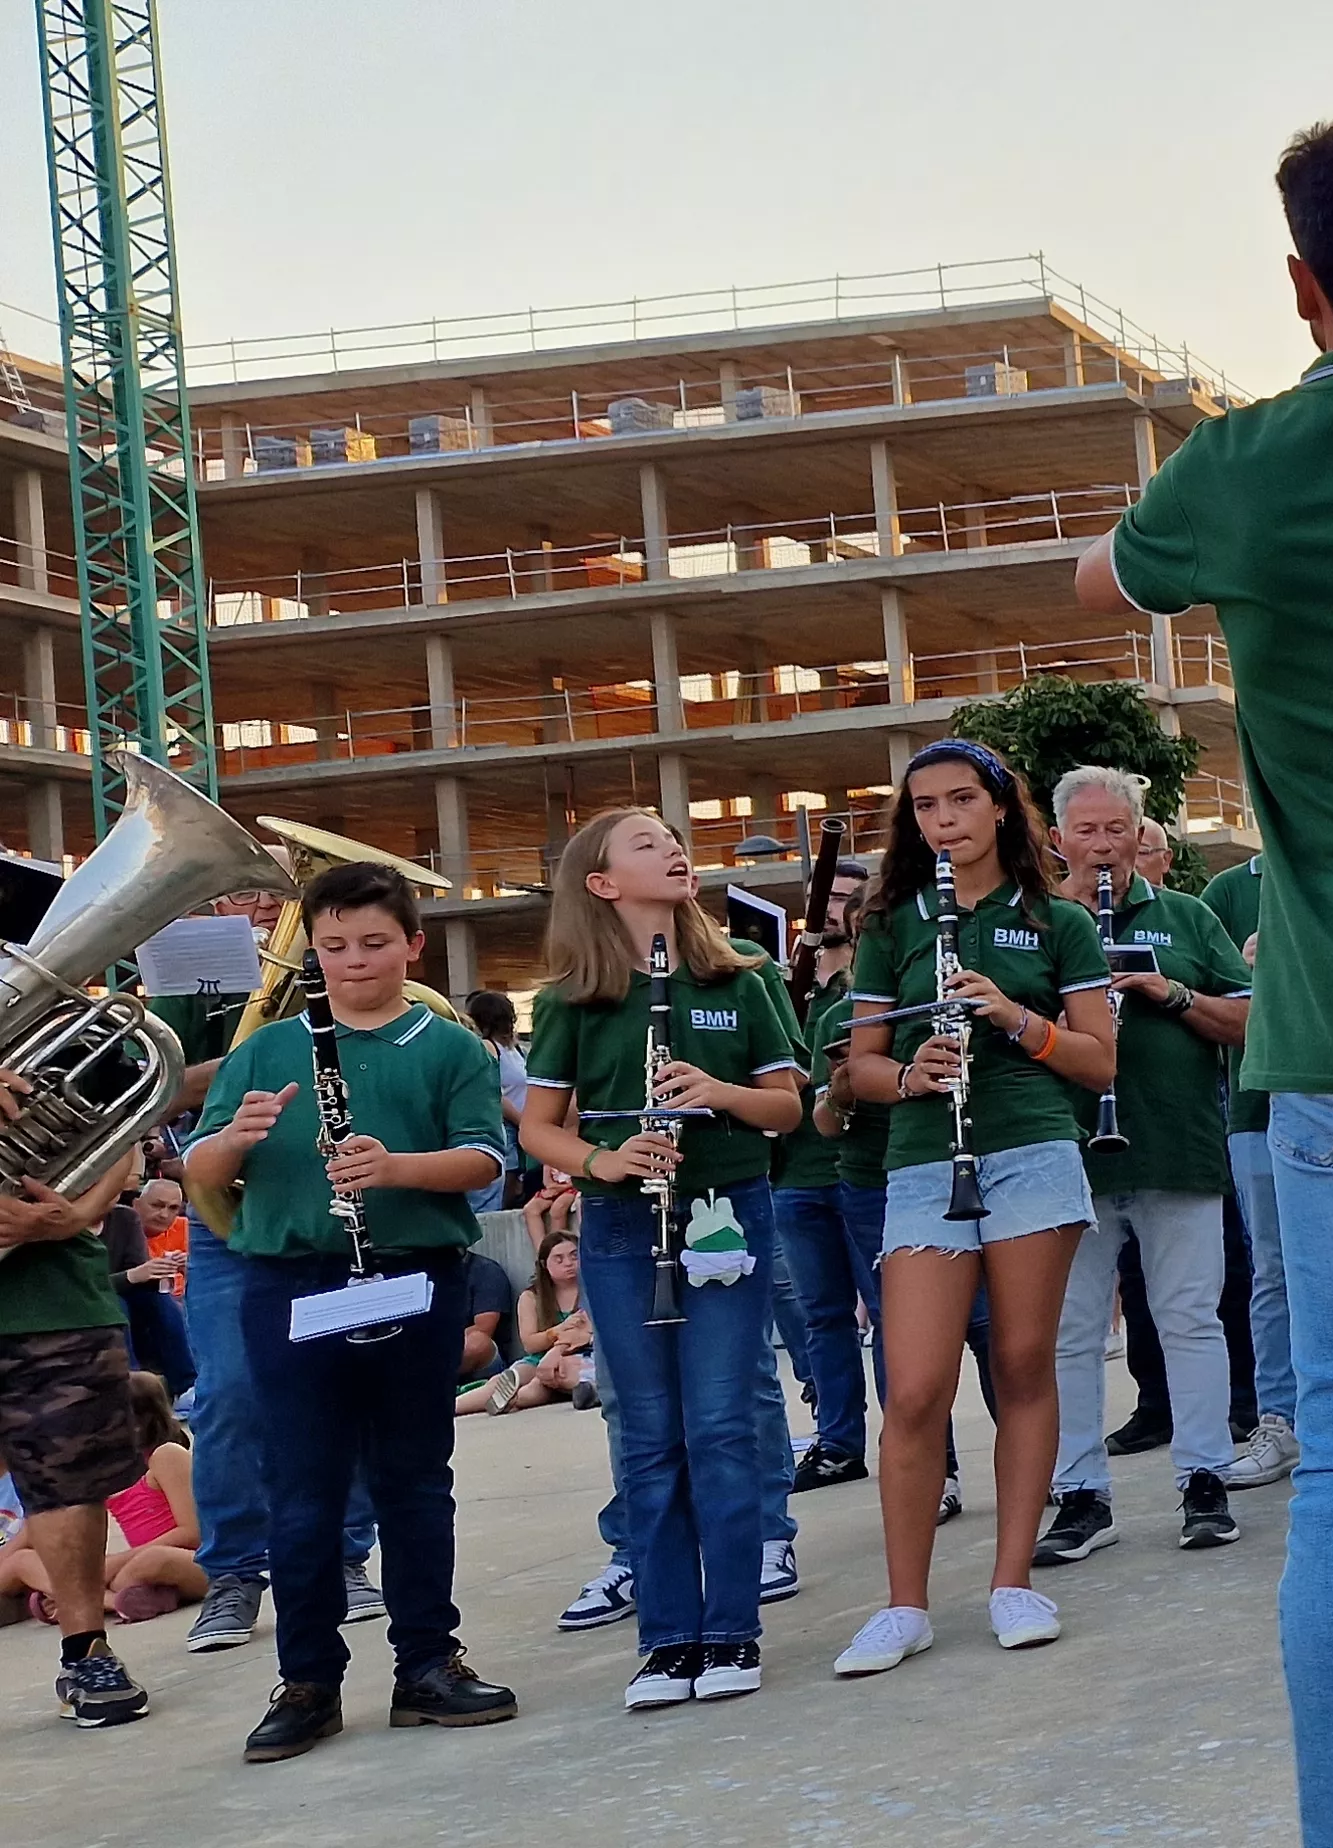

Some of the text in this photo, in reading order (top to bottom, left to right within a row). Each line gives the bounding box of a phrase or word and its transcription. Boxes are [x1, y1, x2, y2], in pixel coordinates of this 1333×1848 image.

[994, 928, 1039, 946] BMH
[1134, 930, 1172, 945] BMH
[690, 1009, 737, 1027] BMH
